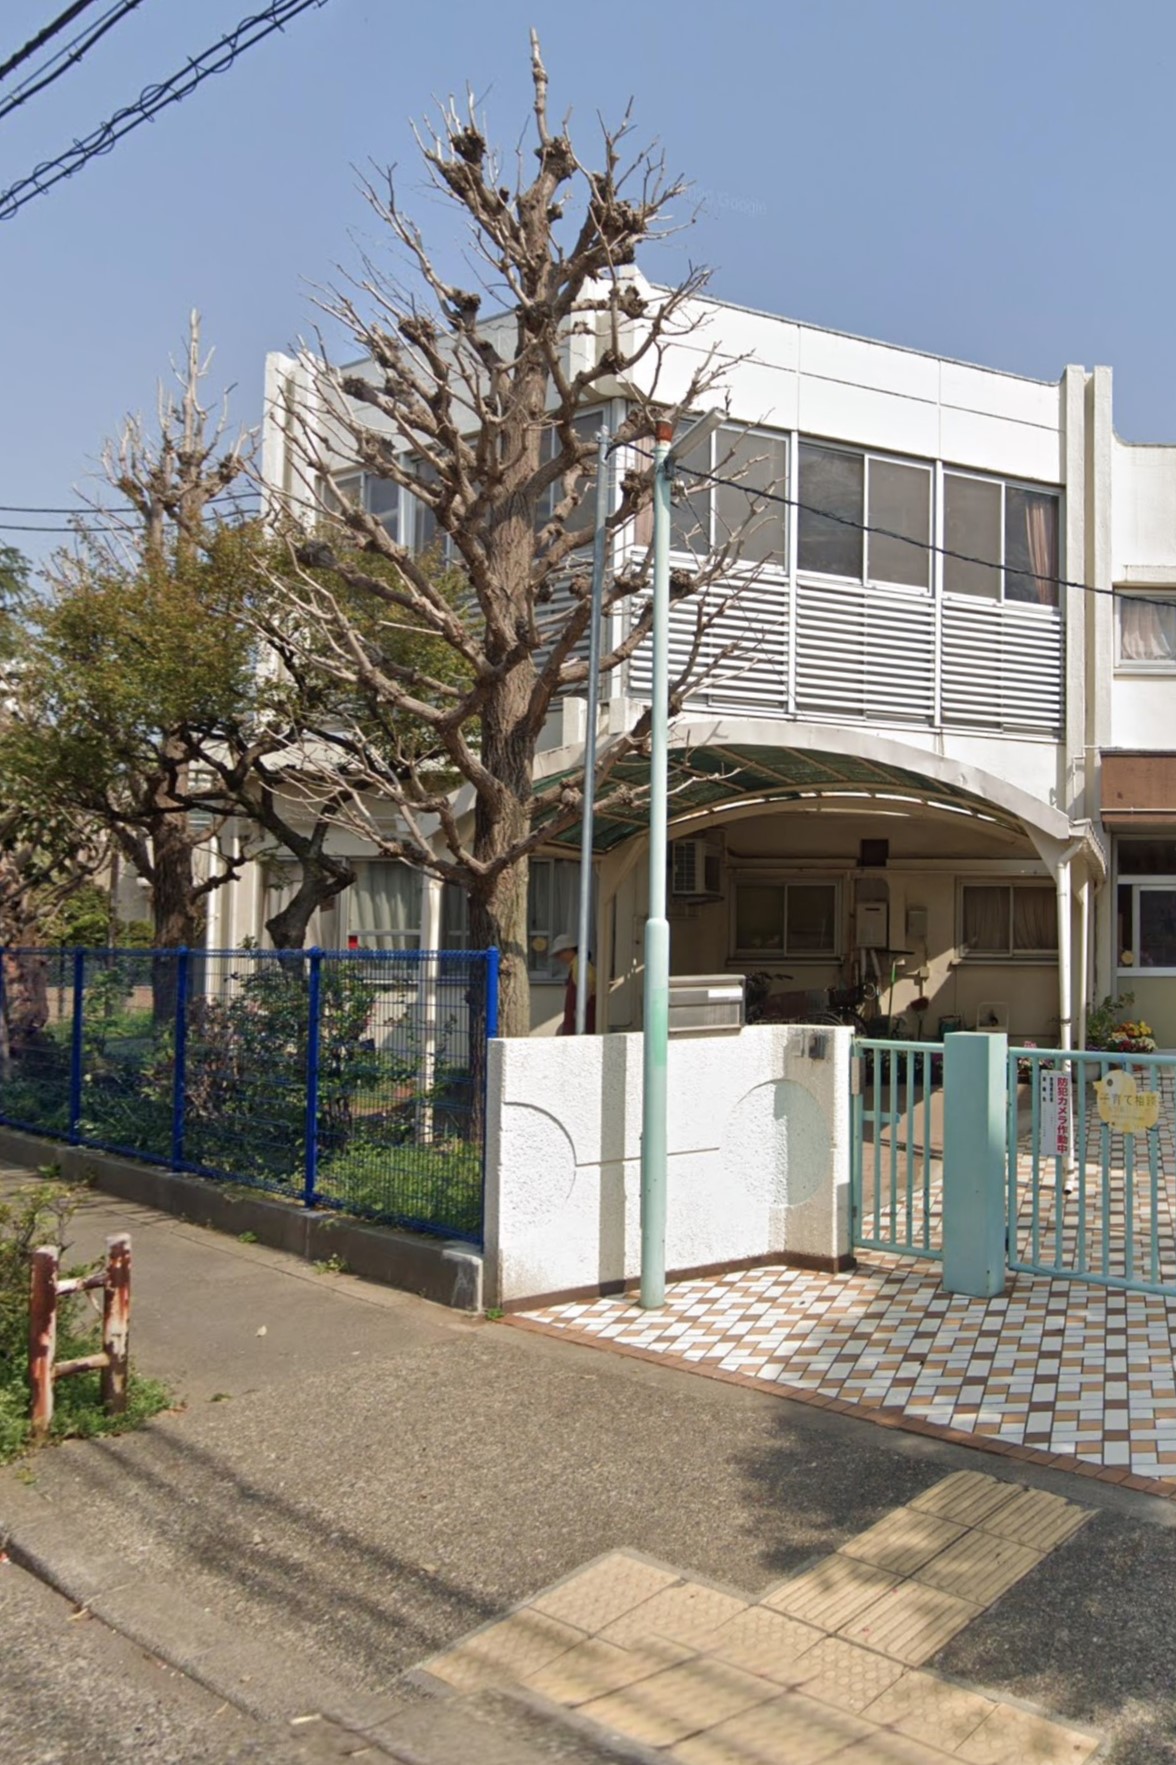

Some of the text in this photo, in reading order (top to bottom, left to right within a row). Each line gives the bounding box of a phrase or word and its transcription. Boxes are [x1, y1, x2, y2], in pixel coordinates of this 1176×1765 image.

[1057, 1077, 1068, 1154] 防犯カメラ作動中
[1099, 1092, 1157, 1107] 子育て相談
